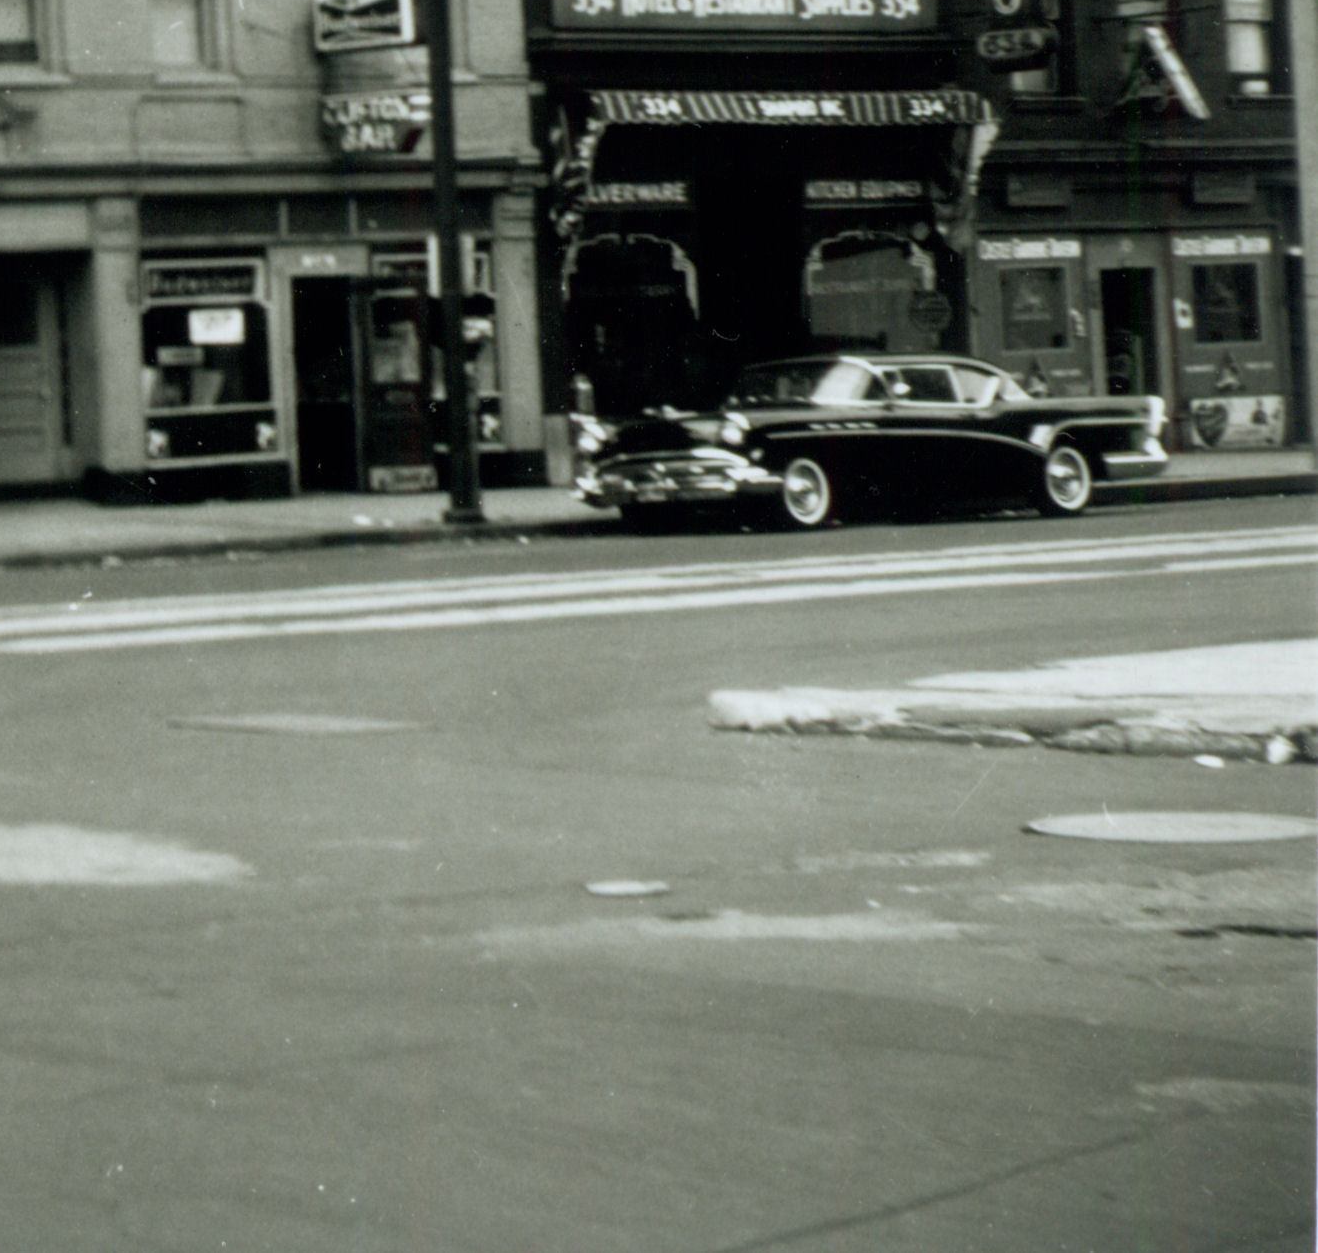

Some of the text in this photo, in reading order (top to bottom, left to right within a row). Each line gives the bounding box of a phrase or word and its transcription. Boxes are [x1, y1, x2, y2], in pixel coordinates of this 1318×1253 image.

[642, 97, 682, 116] 334
[909, 98, 946, 116] 334
[588, 181, 689, 204] LVERWARE
